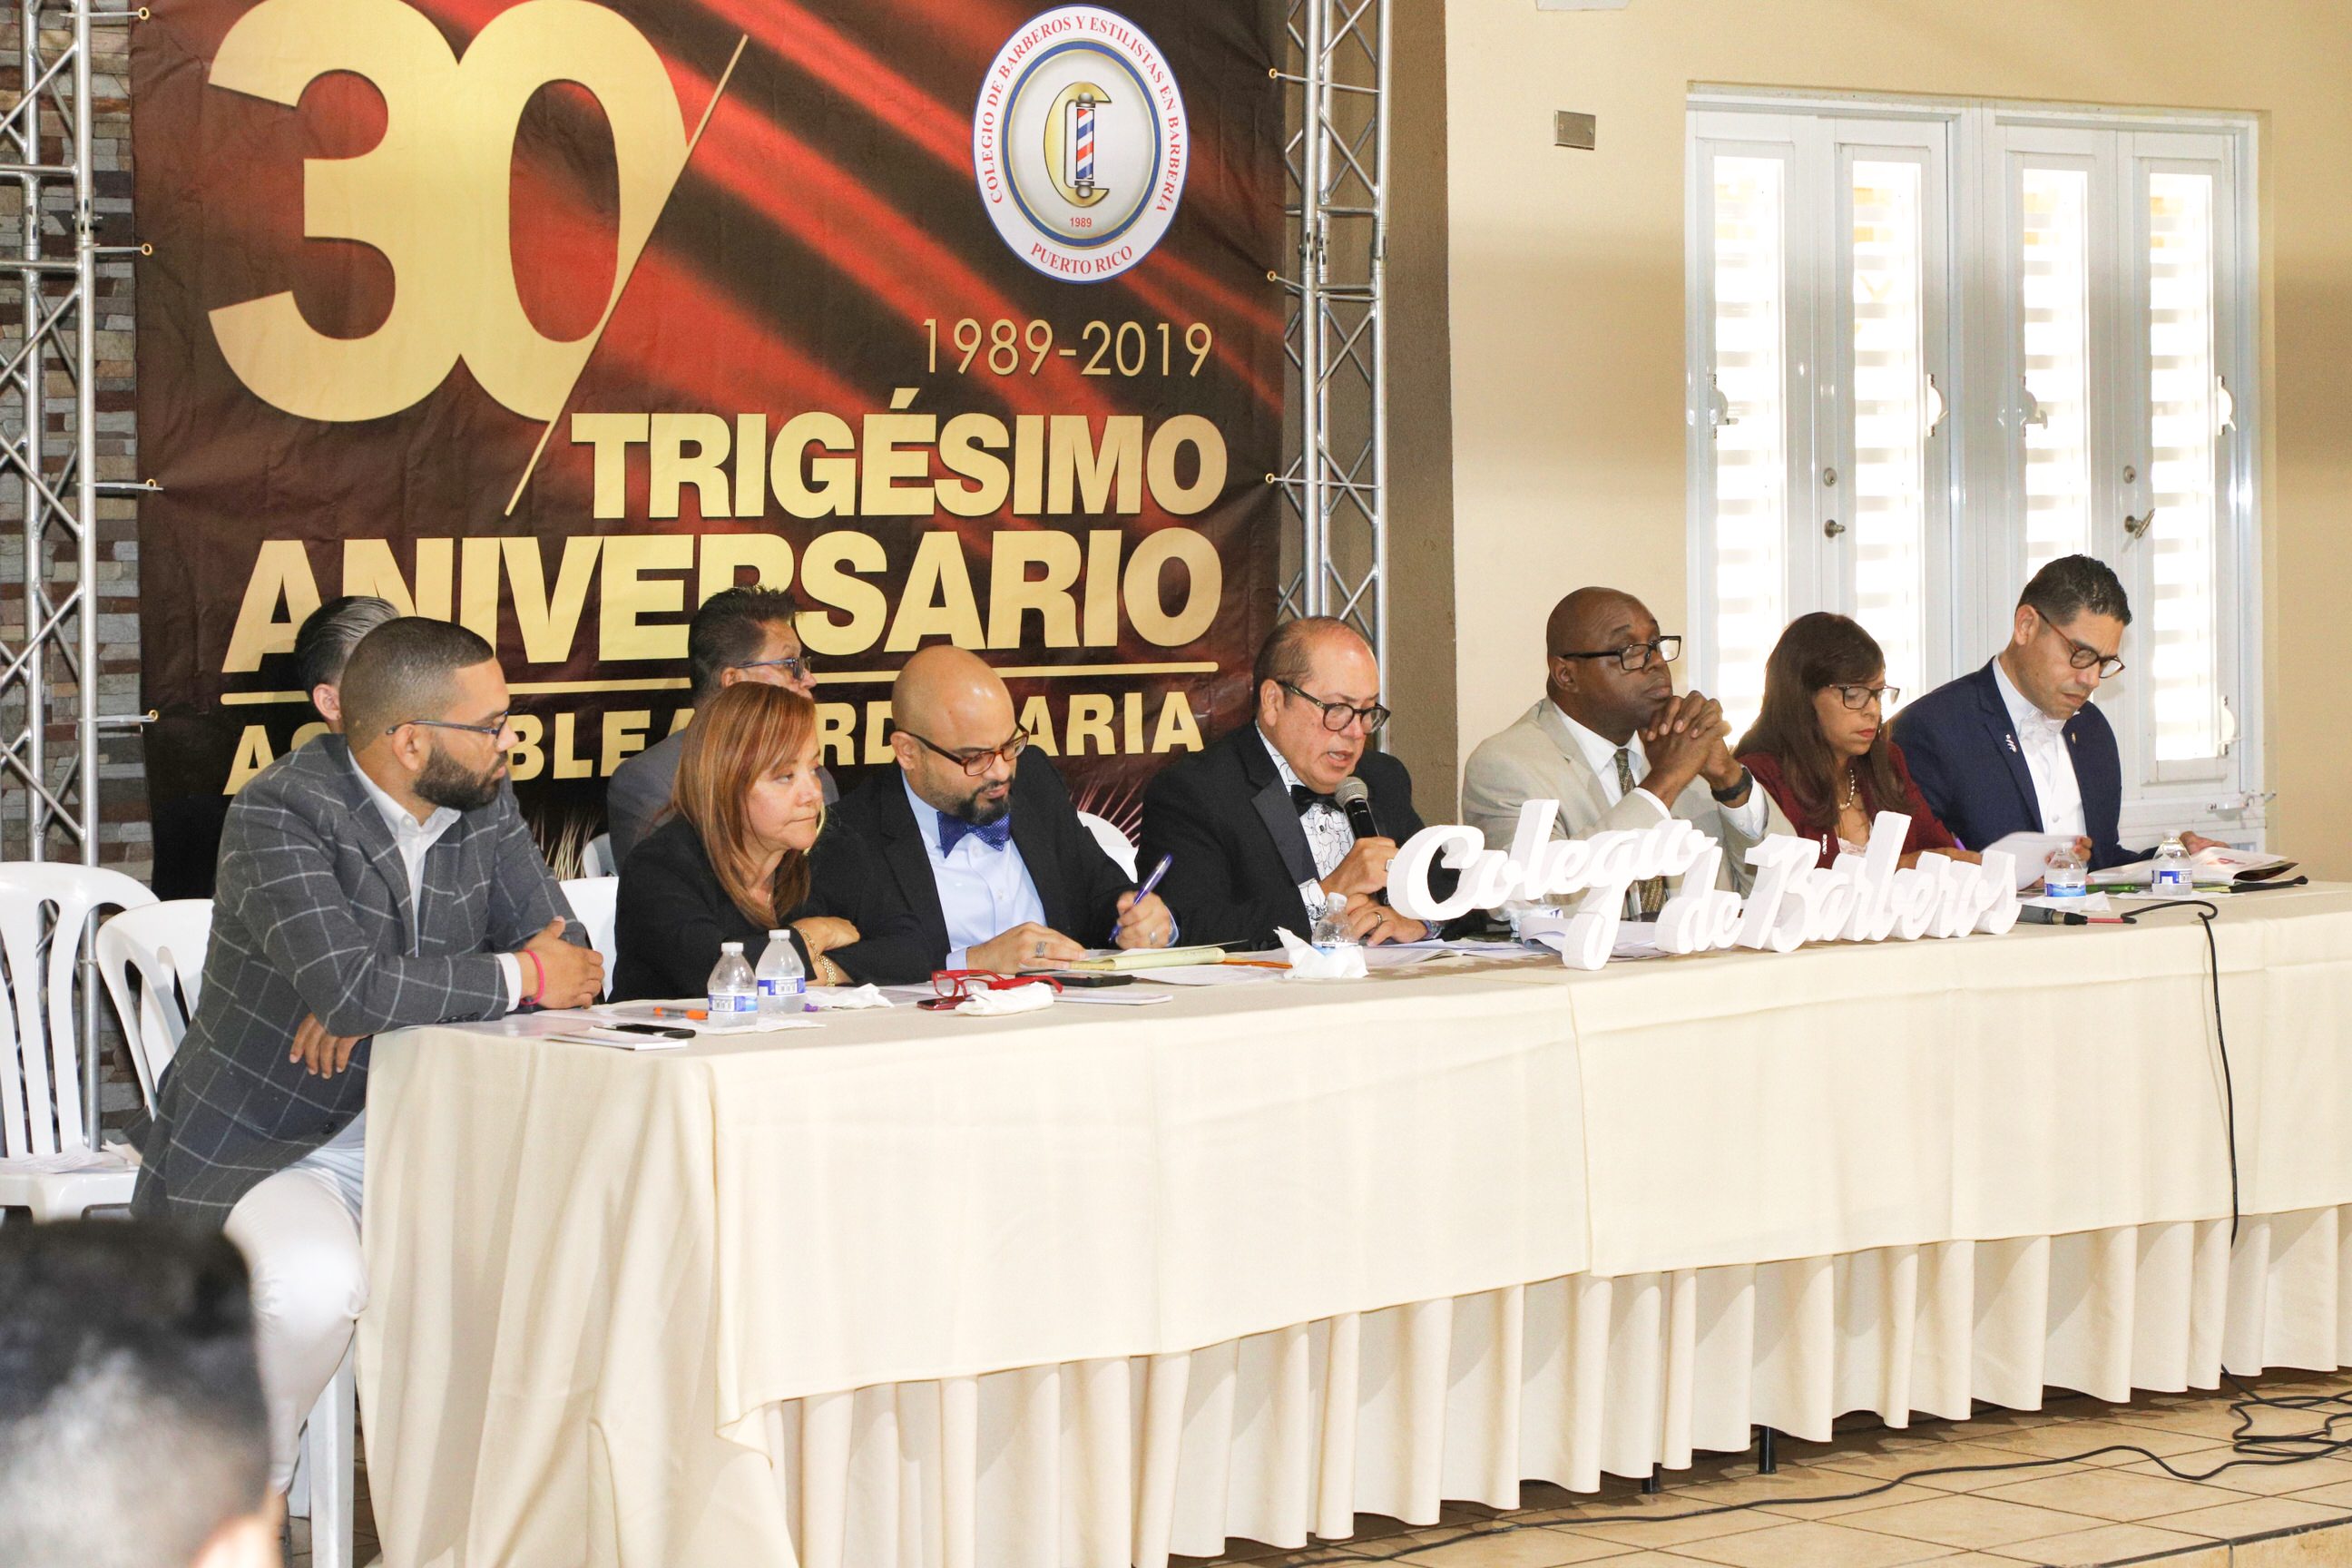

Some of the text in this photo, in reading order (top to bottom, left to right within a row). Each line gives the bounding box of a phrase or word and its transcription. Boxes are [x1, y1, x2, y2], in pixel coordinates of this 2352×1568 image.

[981, 15, 1180, 212] COLEGIO DE BARBEROS Y ESTILISTAS EN BARBERÍA
[1031, 241, 1133, 274] PUERTO RICO
[1069, 217, 1093, 228] 1989
[922, 318, 1215, 377] 1989-2019
[571, 387, 1228, 519] TRIGÉSIMO
[1387, 799, 1718, 971] Colegio
[1655, 810, 2023, 954] de Barberos
